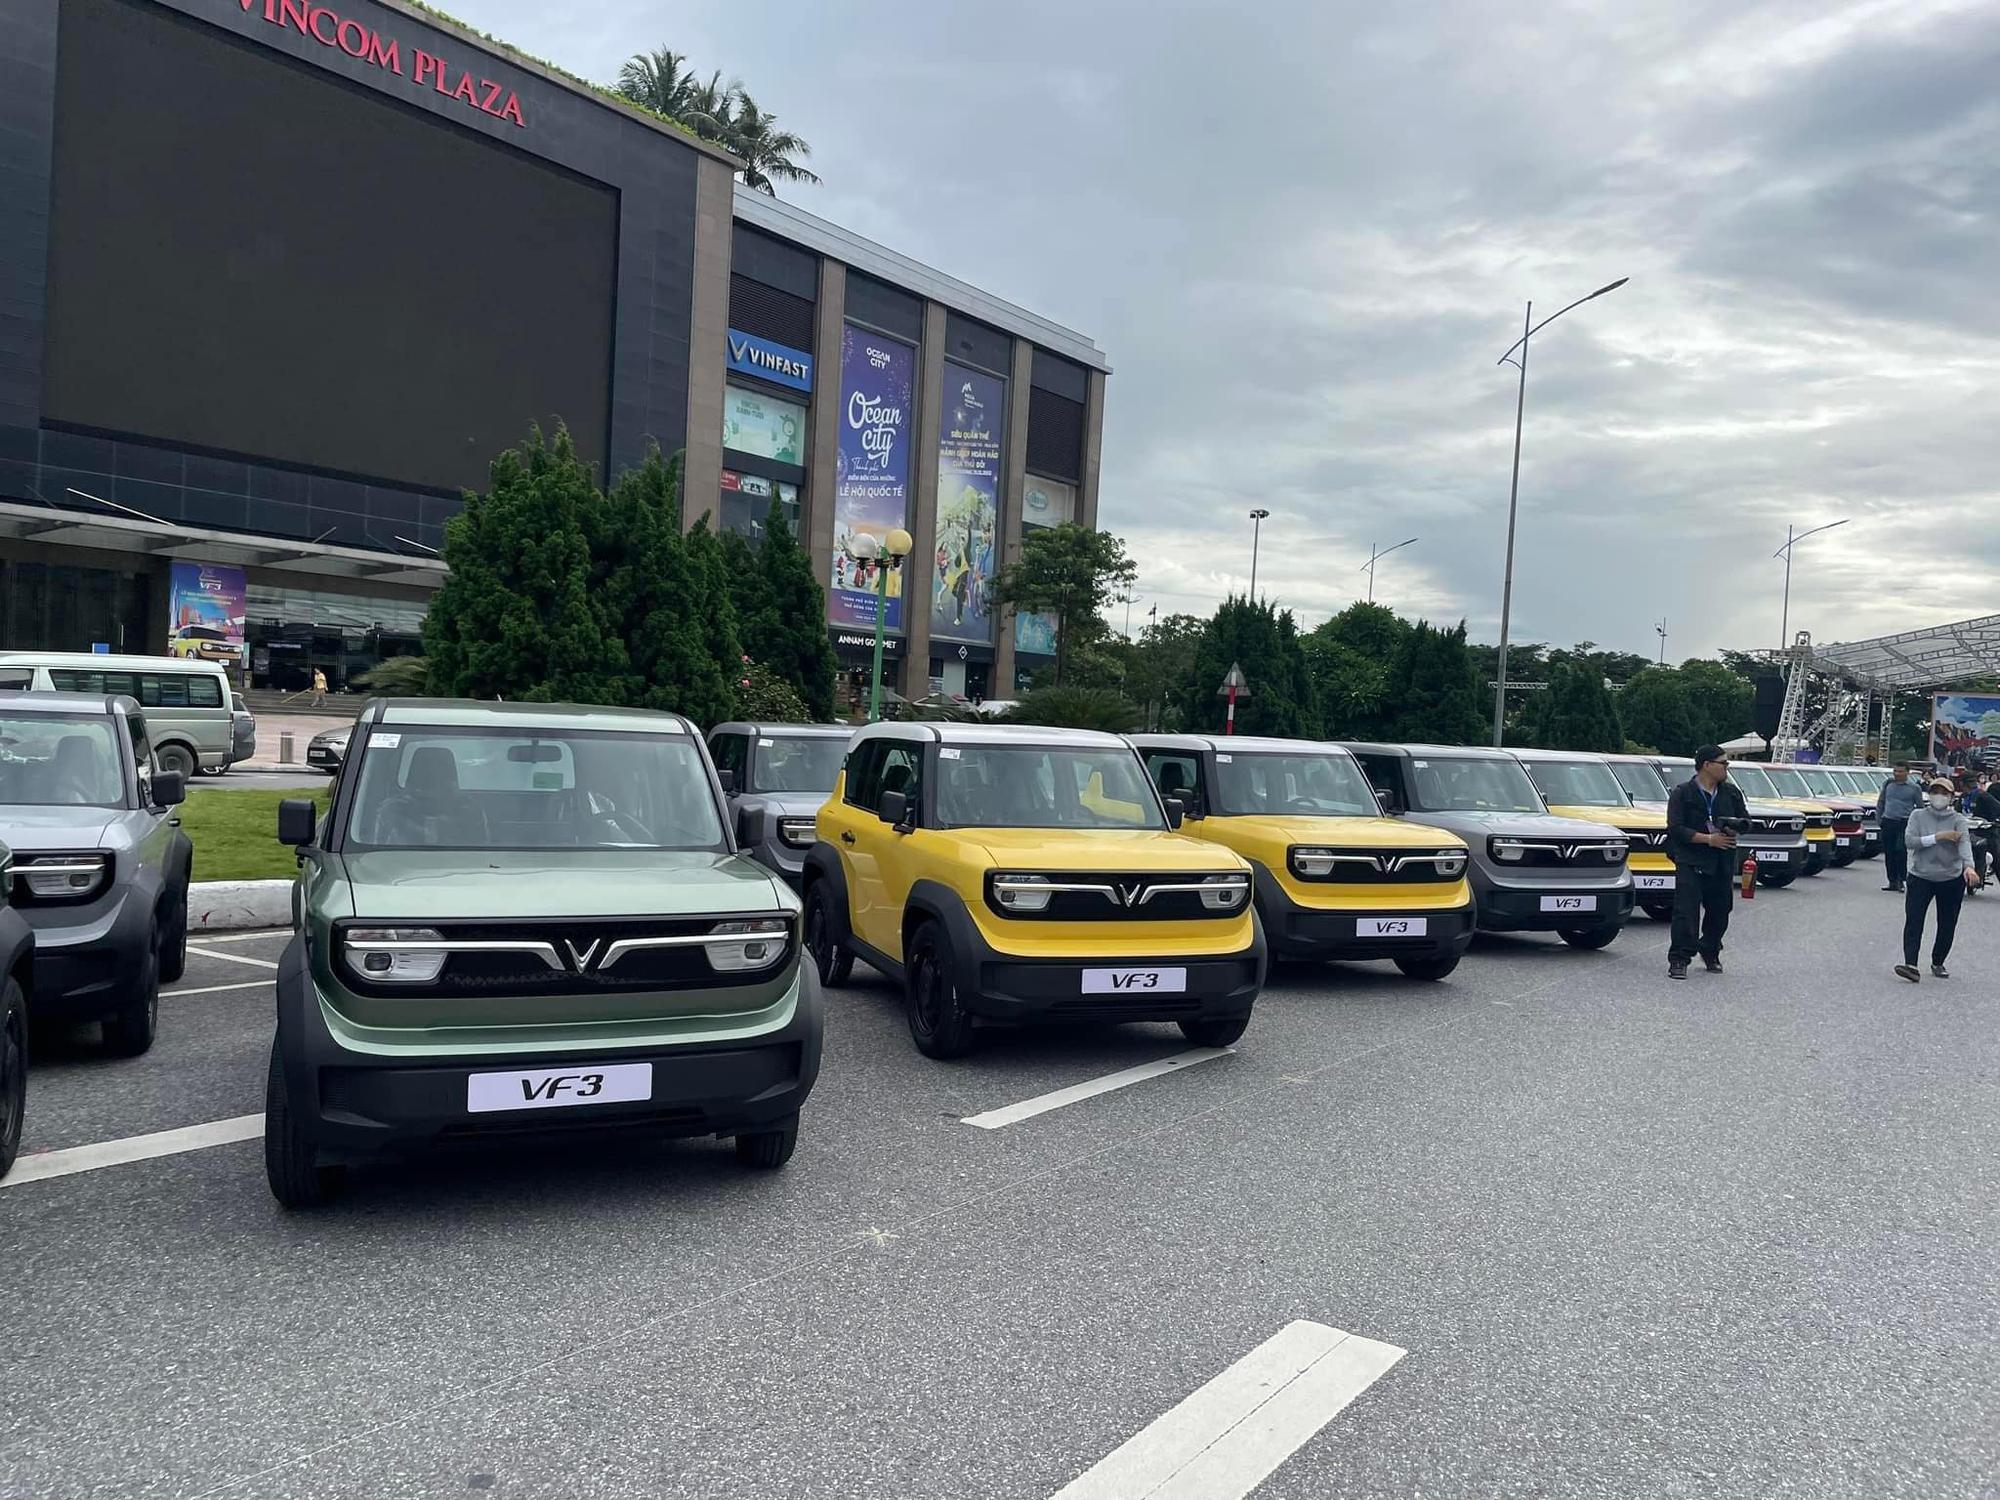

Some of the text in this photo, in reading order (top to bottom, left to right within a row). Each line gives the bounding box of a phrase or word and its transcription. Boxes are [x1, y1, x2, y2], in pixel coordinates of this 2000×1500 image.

[411, 47, 526, 127] PLAZA
[866, 347, 891, 363] OCEAN
[750, 347, 809, 379] VINFAST
[870, 358, 886, 370] CITY
[849, 391, 902, 429] Ocean
[838, 635, 896, 649] ANNAM GOMET
[1643, 878, 1664, 887] VF3
[1555, 898, 1581, 908] VF3
[1377, 921, 1408, 933] VF3
[1112, 973, 1159, 988] VF3
[521, 1074, 604, 1101] VF3
